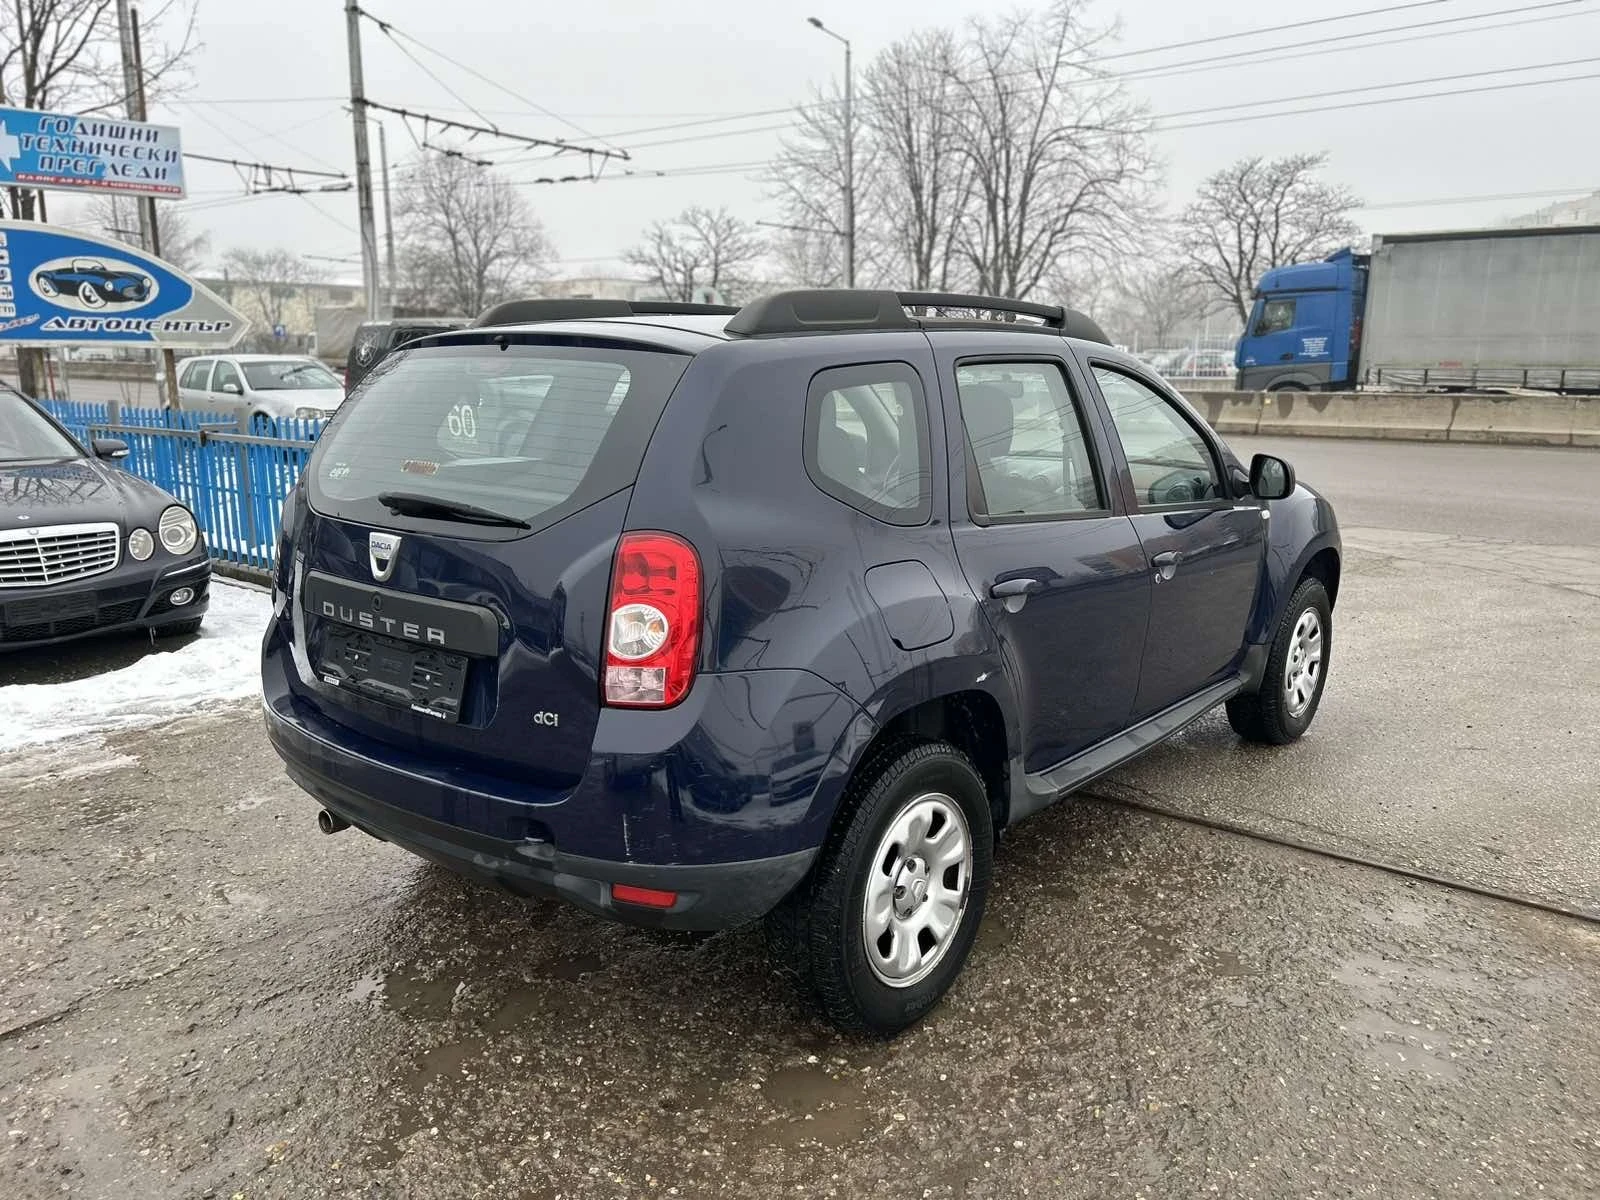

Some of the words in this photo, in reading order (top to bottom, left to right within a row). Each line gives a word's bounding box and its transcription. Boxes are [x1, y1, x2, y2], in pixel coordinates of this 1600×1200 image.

[38, 116, 160, 144] ГОДИШНИ
[20, 133, 179, 164] ТЕХНИЧЕСКИ
[42, 318, 231, 333] АВТОЦЕНТЪР
[370, 540, 393, 551] DACIA
[322, 601, 446, 645] DUSTER
[533, 711, 559, 727] dCi
